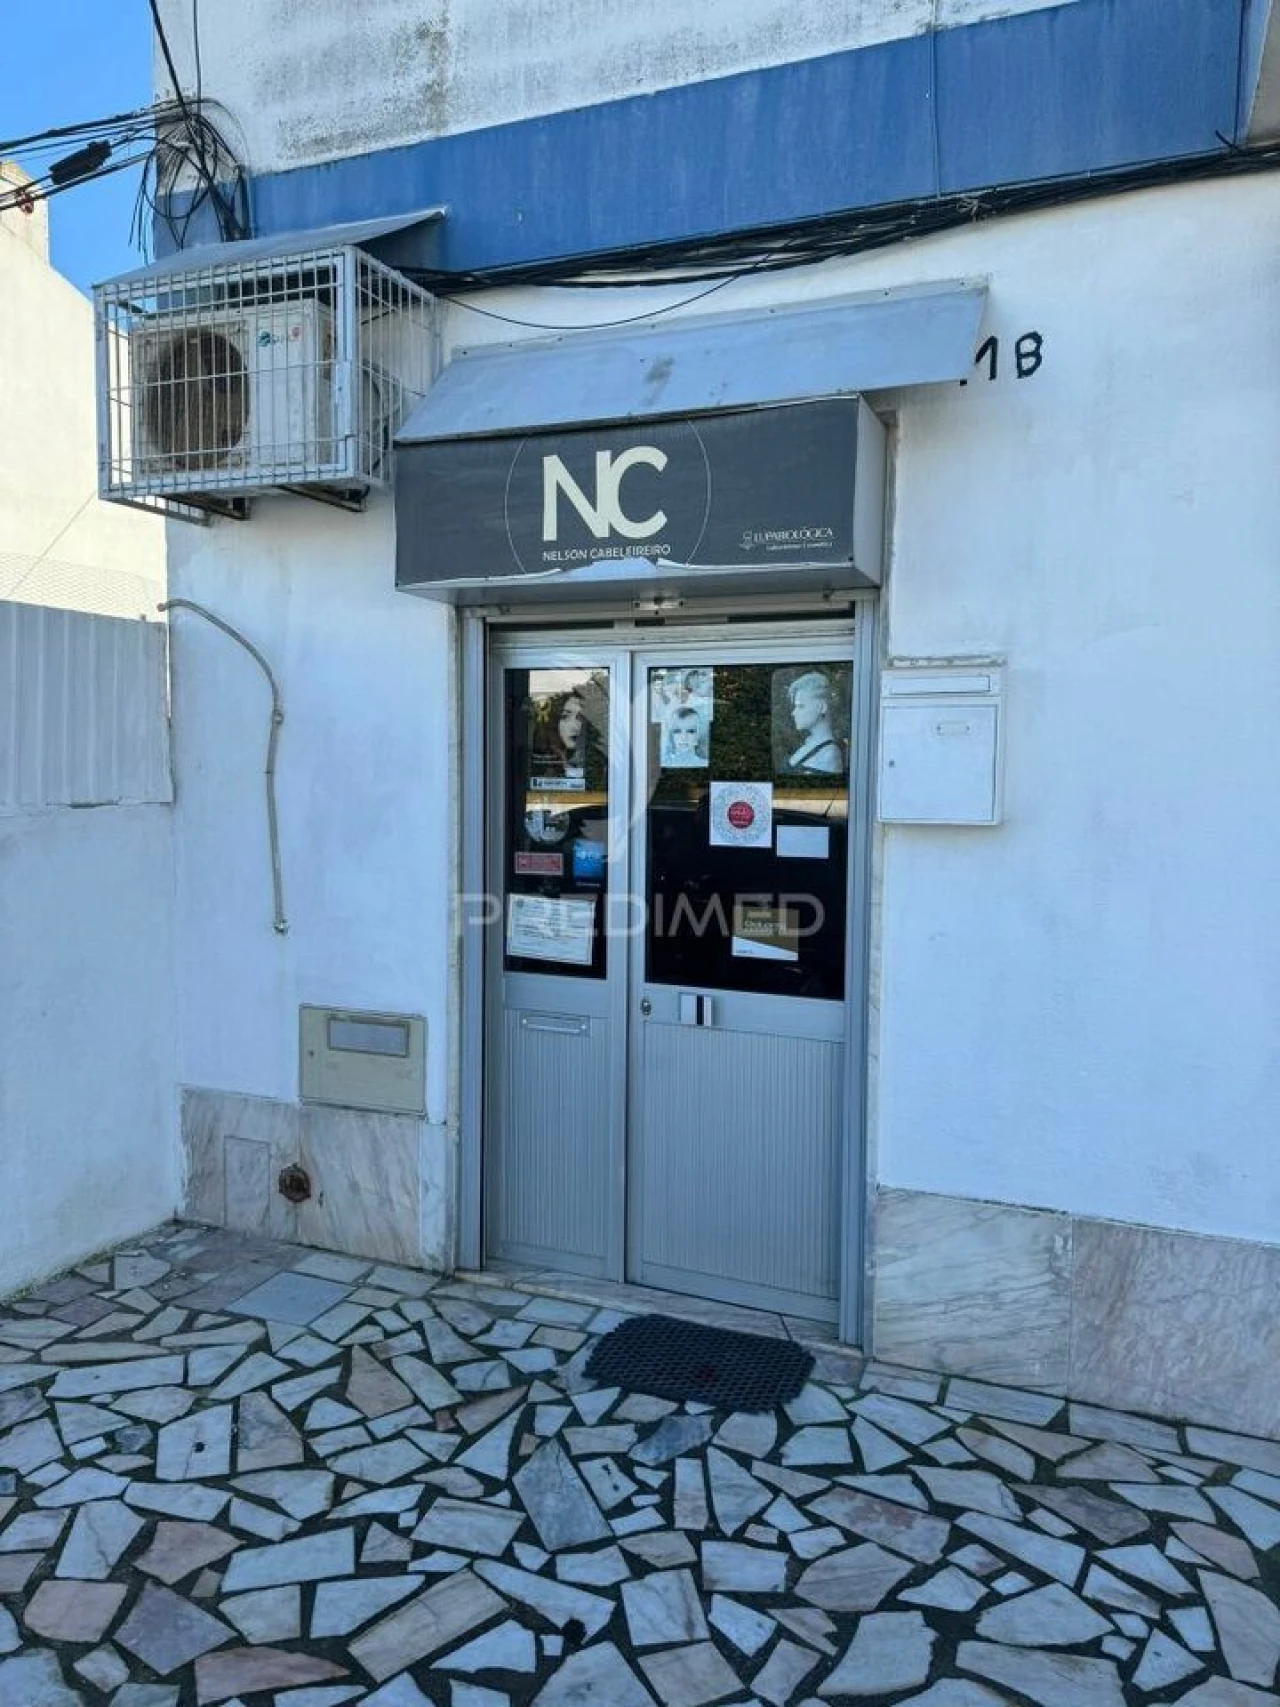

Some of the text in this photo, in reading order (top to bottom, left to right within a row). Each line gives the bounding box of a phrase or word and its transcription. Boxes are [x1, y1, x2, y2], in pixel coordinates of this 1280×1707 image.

[543, 445, 668, 541] NC
[543, 544, 671, 561] NELSON CABELEIREIRO
